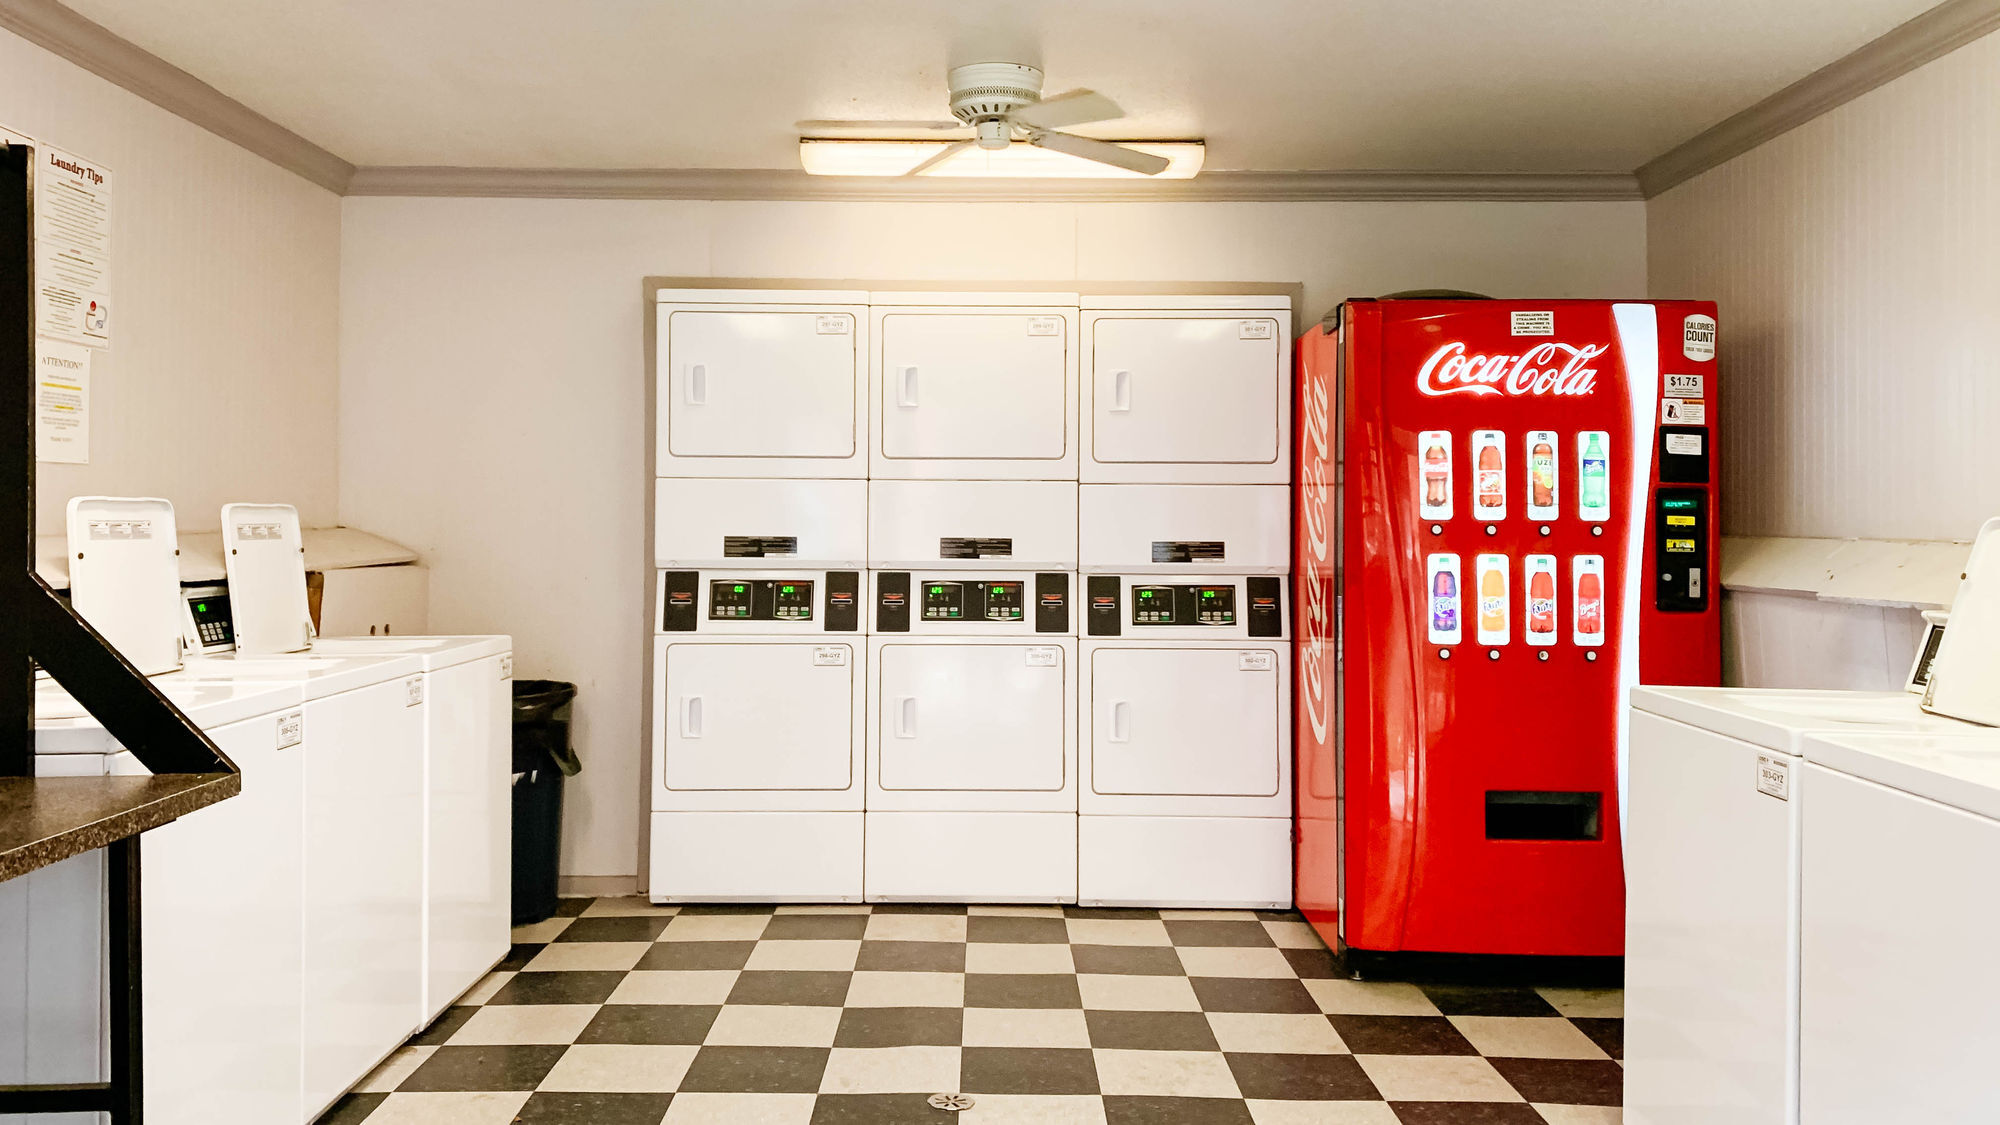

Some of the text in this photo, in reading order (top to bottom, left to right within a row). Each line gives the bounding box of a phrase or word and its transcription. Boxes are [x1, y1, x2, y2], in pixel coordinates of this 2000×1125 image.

[50, 153, 103, 186] Laundry Tips
[1685, 321, 1715, 332] CALORIES
[1685, 330, 1714, 342] COUNT
[1417, 341, 1610, 396] Coca-Cola
[1670, 376, 1698, 387] $1.75
[1302, 359, 1328, 746] Coca-Cola
